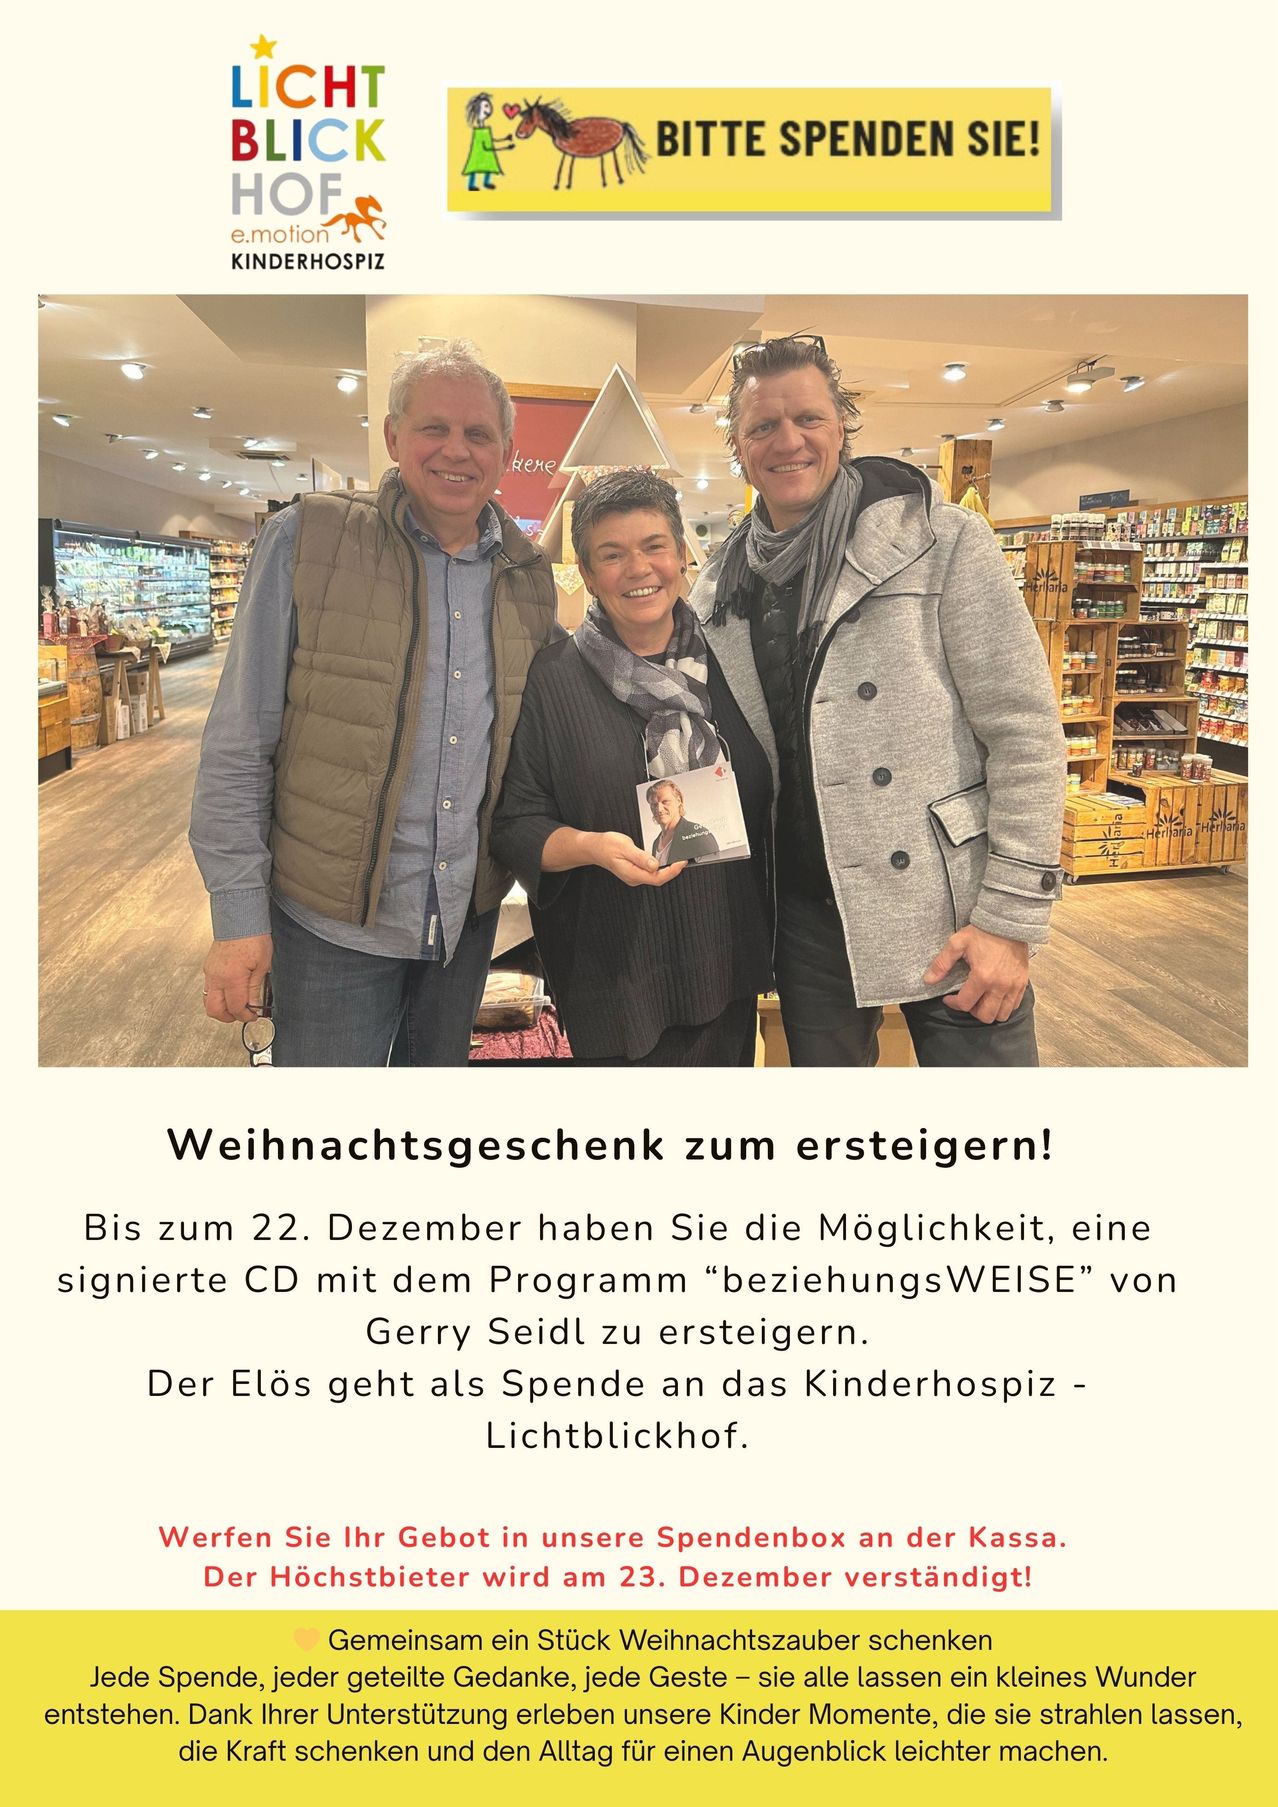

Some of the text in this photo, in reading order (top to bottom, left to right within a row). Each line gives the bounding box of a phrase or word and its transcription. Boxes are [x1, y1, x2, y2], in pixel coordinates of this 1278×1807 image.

[231, 63, 386, 109] LICHT
[231, 118, 387, 162] BLICK
[656, 119, 1040, 157] BITTE SPENDEN SIE!
[231, 171, 343, 217] HOF
[230, 224, 330, 244] e.motion
[231, 252, 385, 271] KINDERHOSPIZ
[1025, 580, 1068, 593] Herbaria
[1146, 825, 1193, 840] Herbaria
[1201, 820, 1246, 833] Herbaria
[167, 1128, 1050, 1168] Weihnachtsgeschenk zum ersteigern!
[86, 1213, 1149, 1247] Bis zum 22. Dezember haben Sie die Möglichkeit, eine
[58, 1265, 1175, 1299] signierte CD mit dem Programm “beziehungsWEISE” von
[367, 1317, 867, 1351] Gerry Seidl zu ersteigern.
[149, 1369, 214, 1397] Der
[233, 1369, 310, 1397] Elös
[329, 1369, 414, 1403] geht
[431, 1369, 483, 1397] als
[503, 1369, 643, 1403] Spende
[663, 1377, 703, 1397] an
[723, 1369, 786, 1397] das
[806, 1369, 1055, 1403] Kinderhospiz
[488, 1421, 747, 1449] Lichtblickhof.
[159, 1526, 1065, 1552] Werfen Sie Ihr Gebot in unsere Spendenbox an der Kassa.
[205, 1565, 1031, 1592] Der Höchstbieter wird am 23. Dezember verständigt!
[329, 1628, 992, 1651] Gemeinsam ein Stück Weihnachtszauber schenken
[90, 1666, 149, 1688] Jede
[159, 1666, 264, 1693] Spende,
[271, 1666, 339, 1693] jeder
[348, 1666, 445, 1693] geteilte
[454, 1666, 576, 1692] Gedanke,
[583, 1666, 640, 1693] jede
[649, 1666, 728, 1688] Geste
[758, 1666, 795, 1688] sie
[803, 1666, 848, 1688] alle
[858, 1666, 942, 1688] lassen
[950, 1666, 987, 1688] ein
[996, 1666, 1086, 1688] kleines
[1096, 1666, 1196, 1688] Wunder
[45, 1703, 1242, 1730] entstehen. Dank Ihrer Unterstützung erleben unsere Kinder Momente, die sie strahlen lassen,
[178, 1740, 1107, 1768] die Kraft schenken und den Alltag für einen Augenblick leichter machen.
